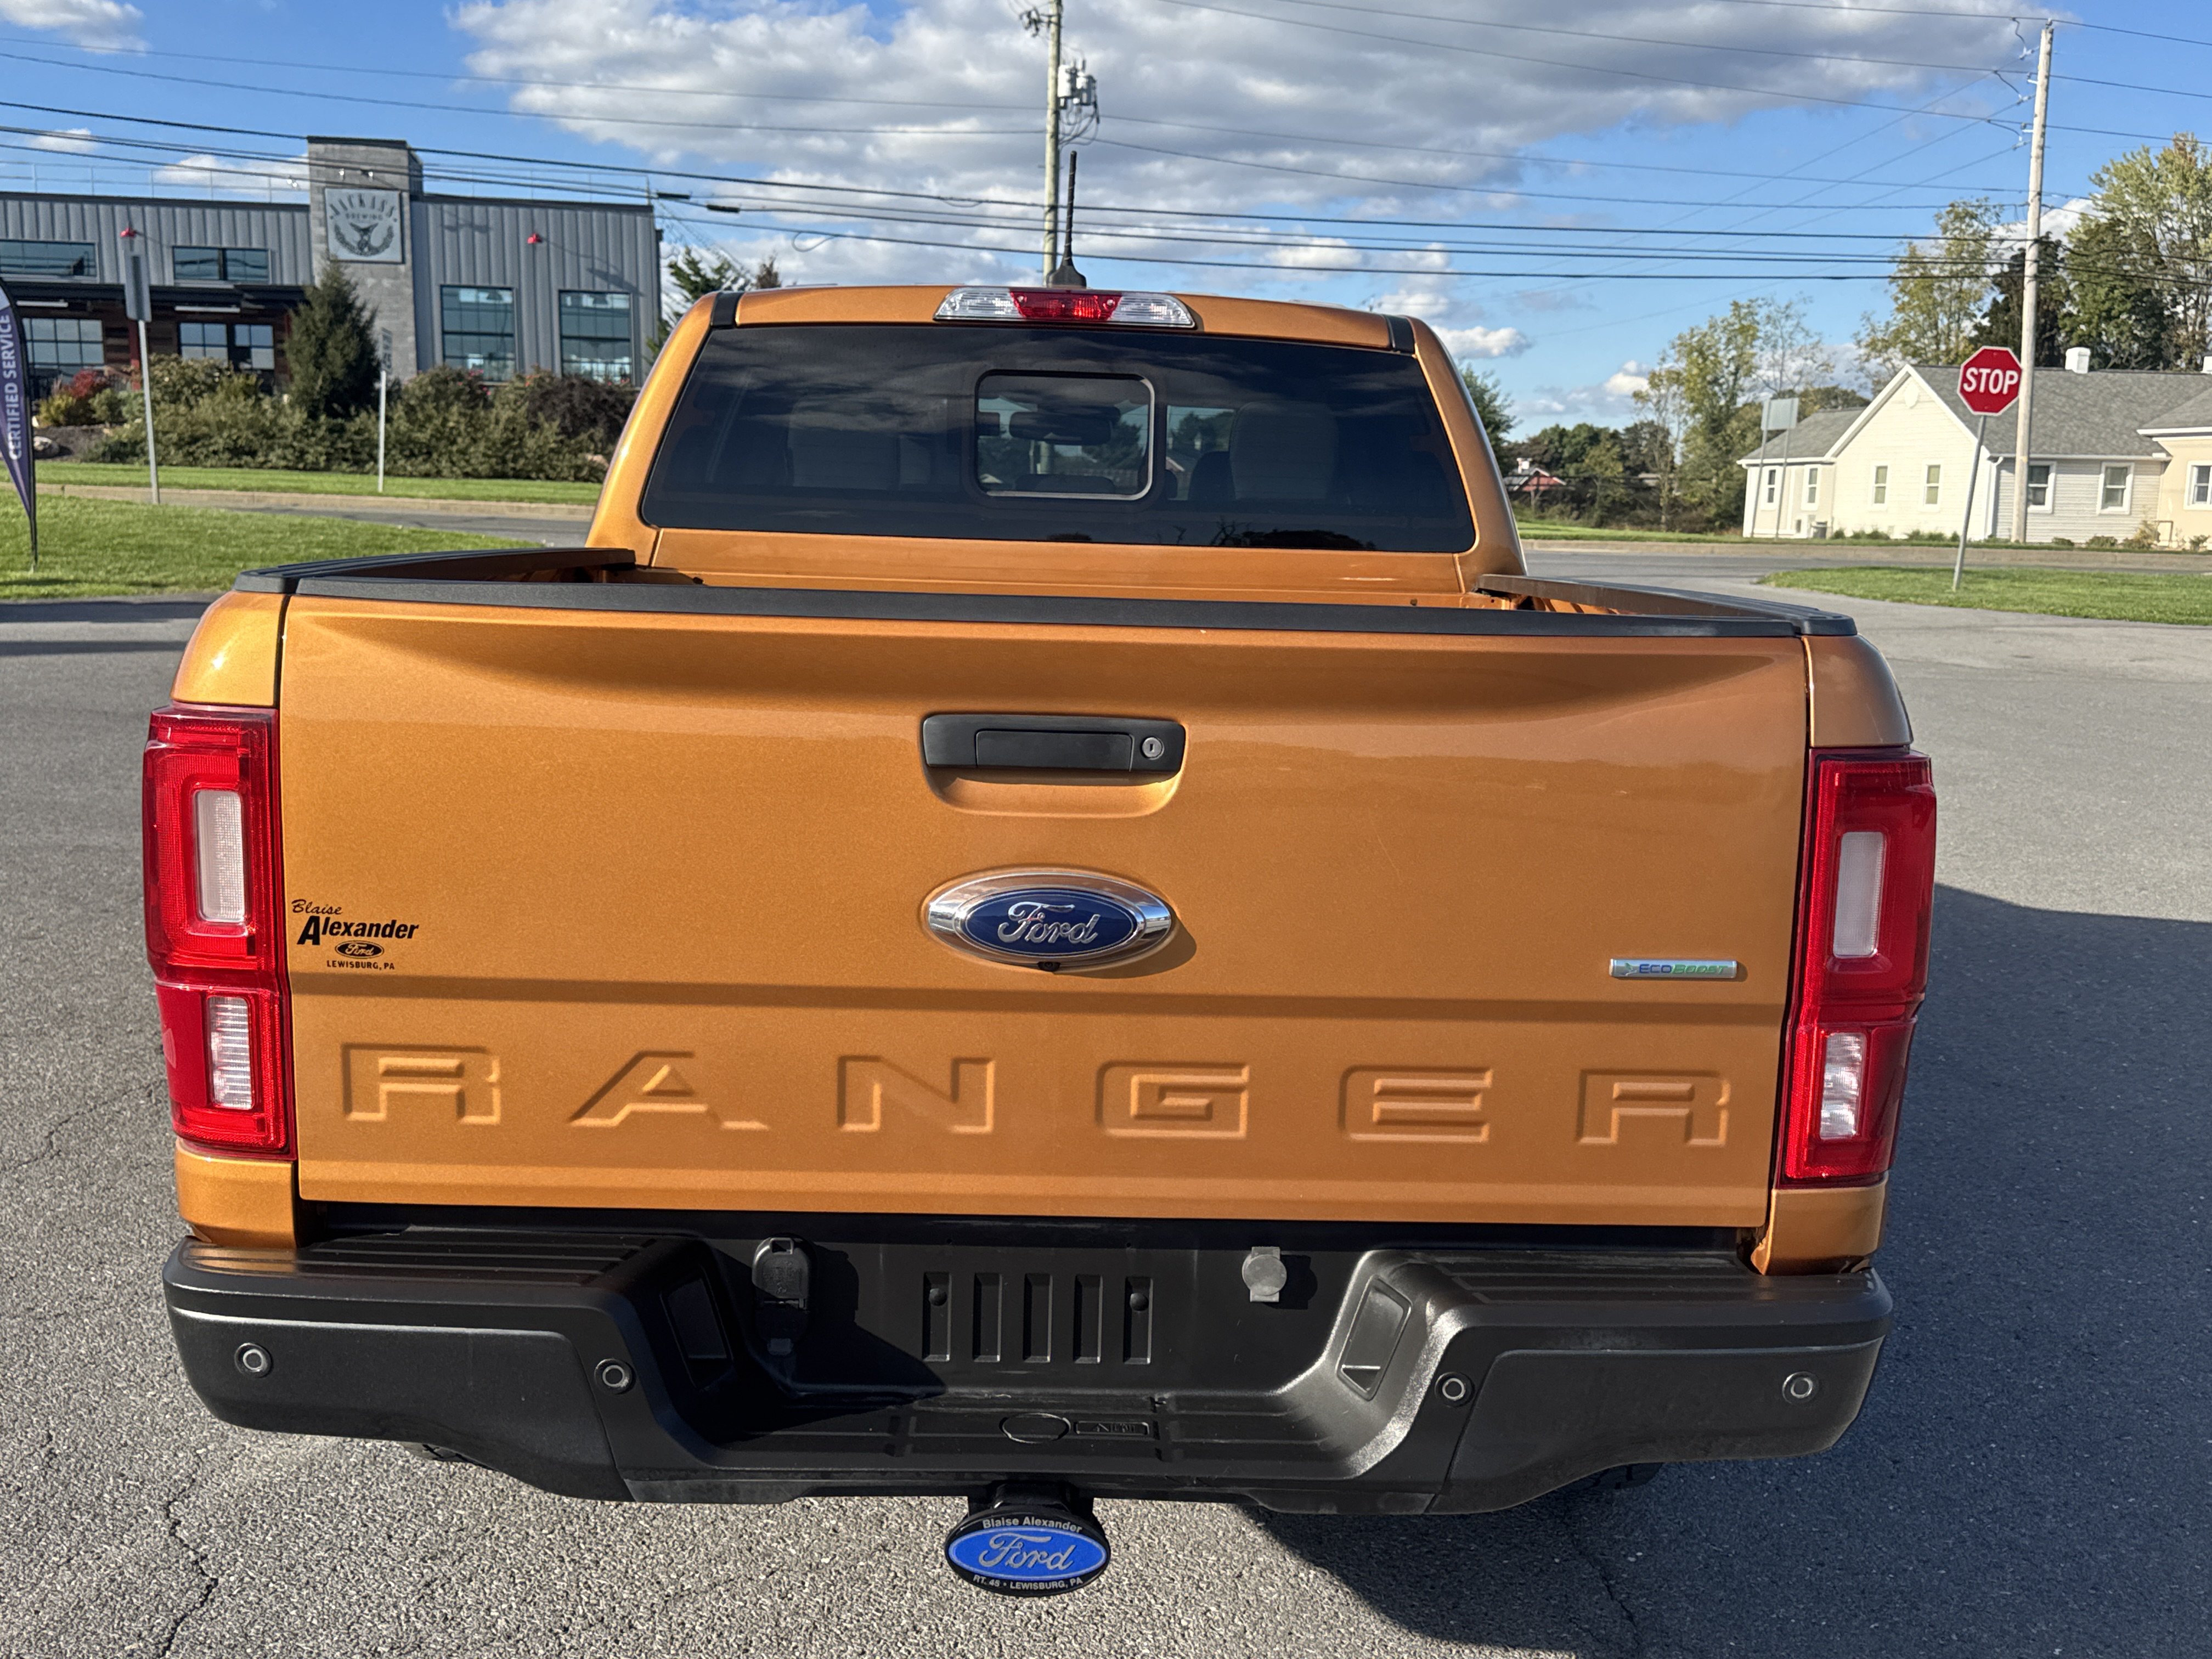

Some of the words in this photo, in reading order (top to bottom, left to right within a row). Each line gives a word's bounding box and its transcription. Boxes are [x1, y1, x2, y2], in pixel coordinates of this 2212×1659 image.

[0, 315, 17, 379] SERVICE
[1962, 366, 2019, 395] STOP
[4, 382, 22, 460] CERTIFIED
[291, 899, 343, 915] Blaise
[297, 915, 419, 945] Alexander
[997, 901, 1101, 945] Ford
[345, 943, 375, 956] Ford
[326, 960, 382, 970] LEWISBURG,
[341, 1042, 1732, 1146] RANGER
[982, 1517, 1019, 1529] Blaise
[1022, 1516, 1083, 1533] Alexander
[978, 1532, 1076, 1570] Ford
[973, 1574, 987, 1585] RT.
[989, 1578, 1001, 1588] 45
[1009, 1580, 1068, 1590] LEWISBURG,
[1069, 1577, 1084, 1587] PA
